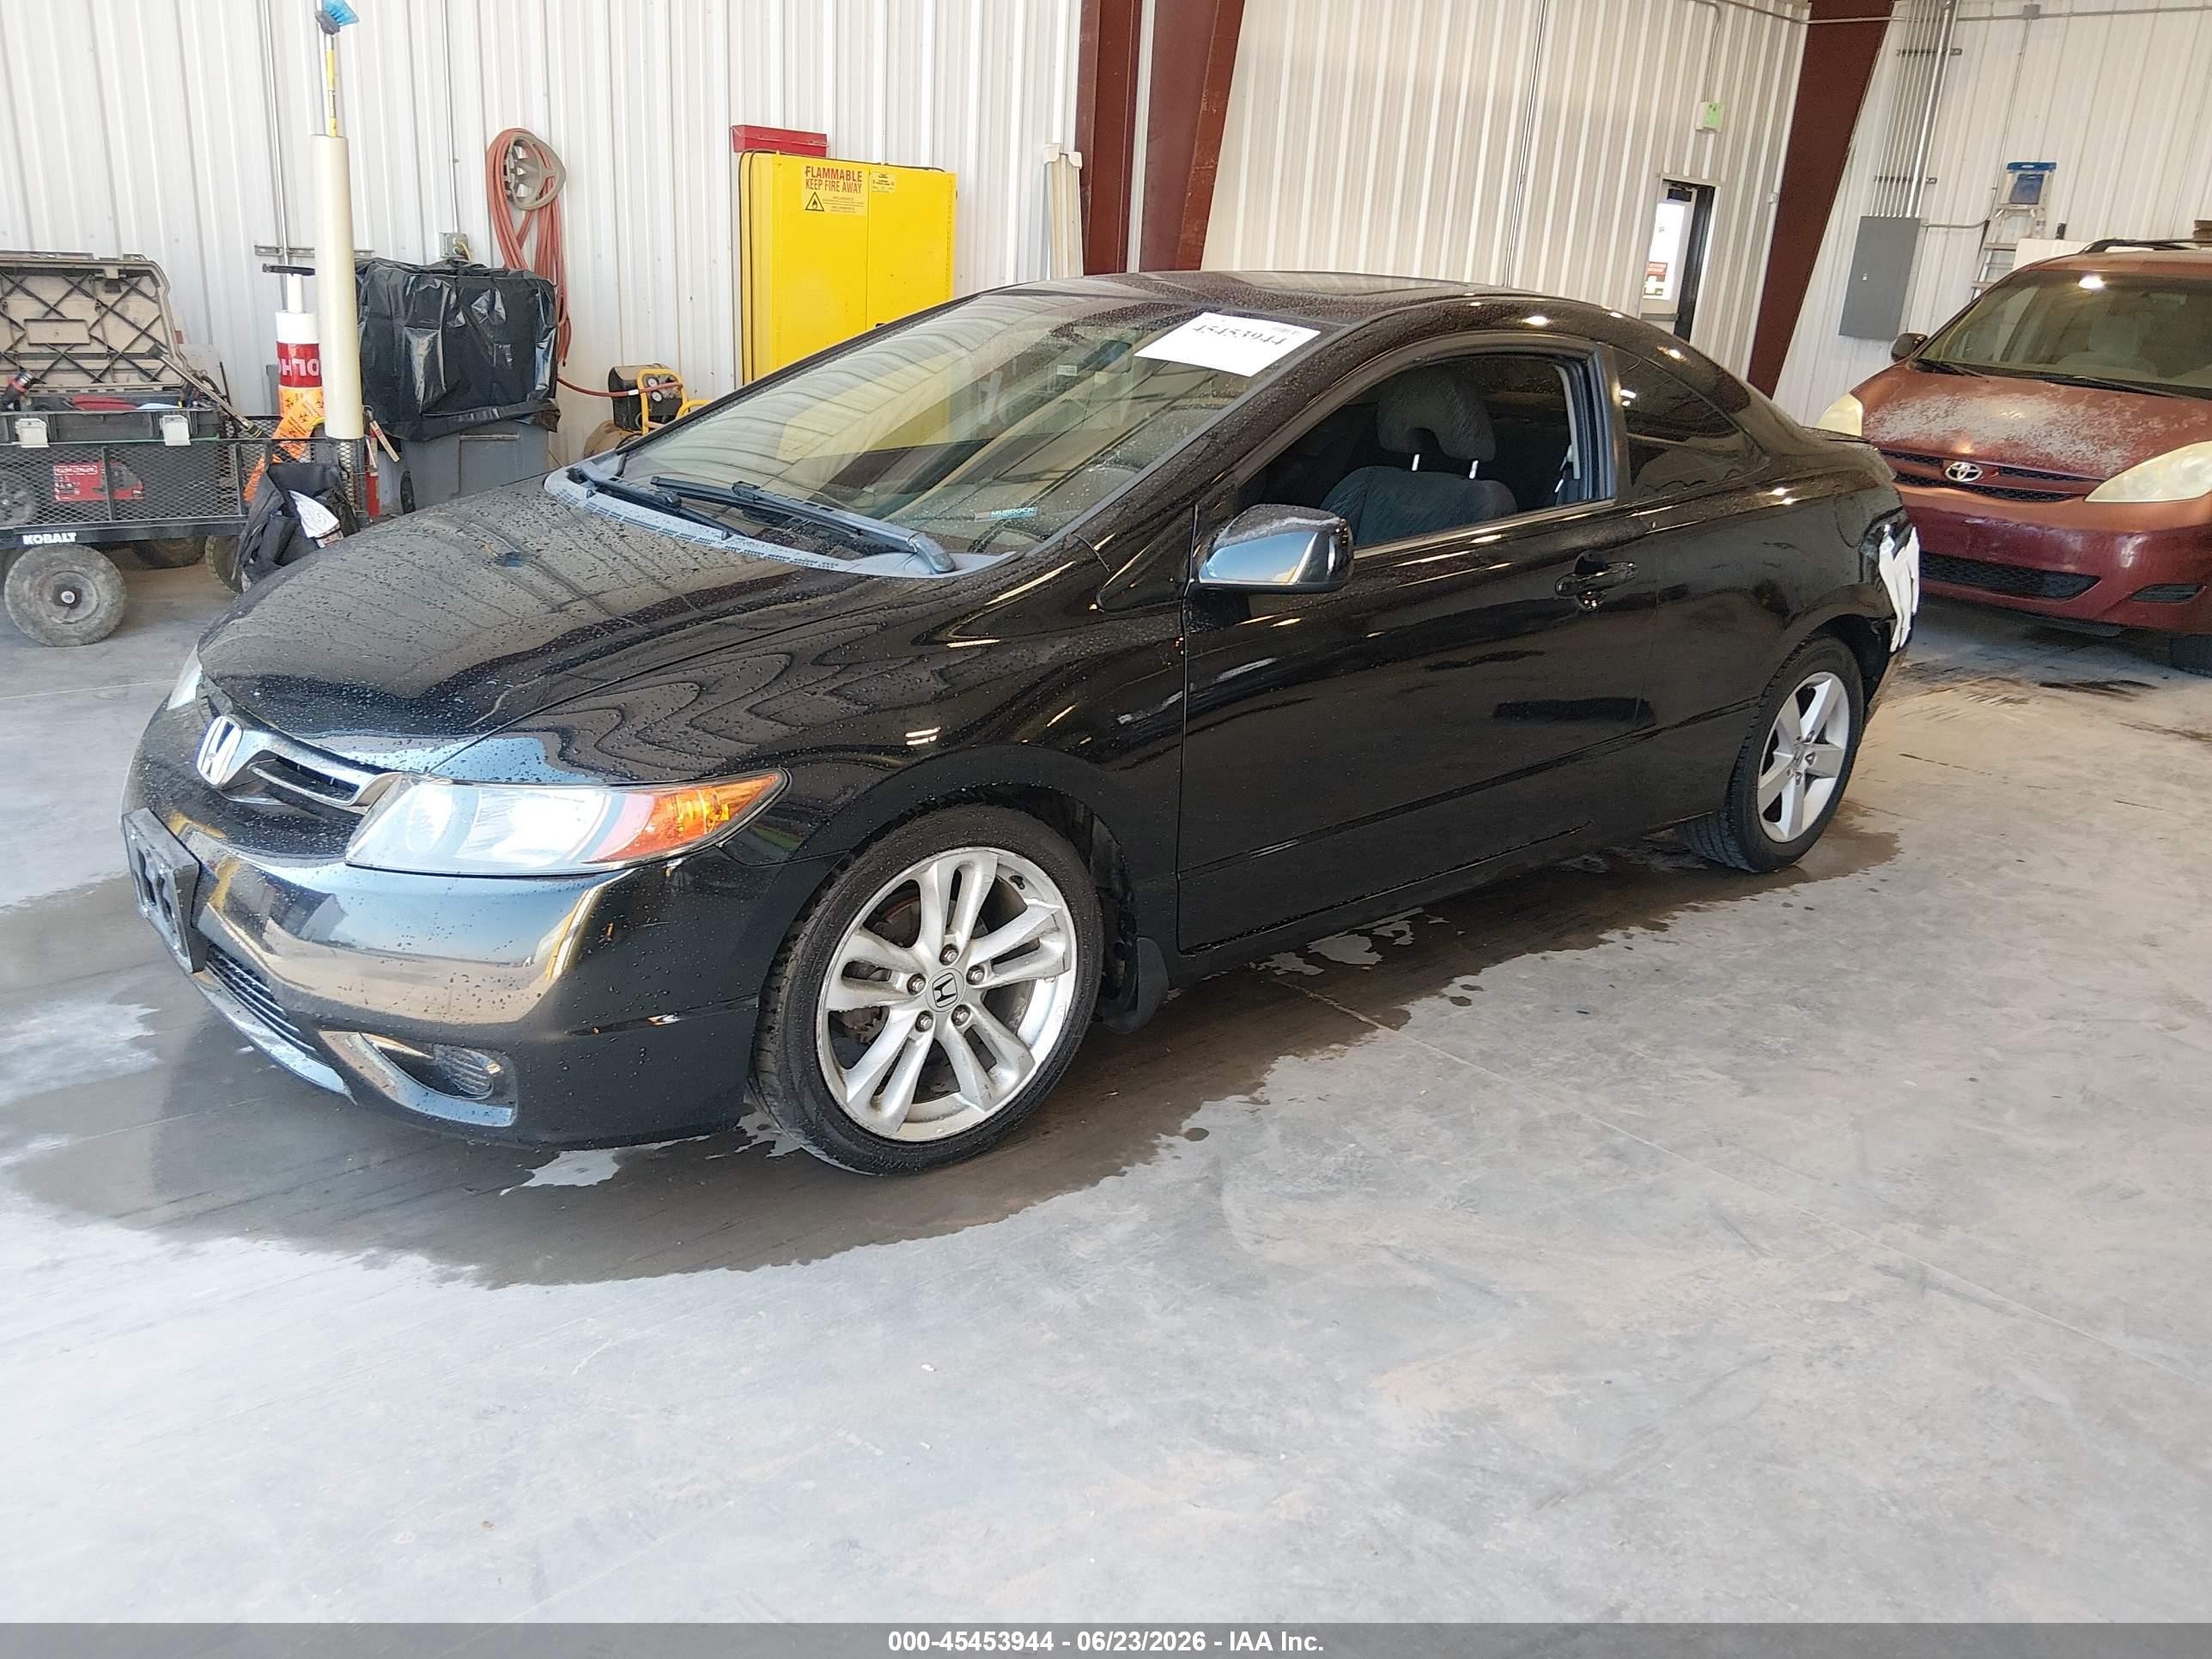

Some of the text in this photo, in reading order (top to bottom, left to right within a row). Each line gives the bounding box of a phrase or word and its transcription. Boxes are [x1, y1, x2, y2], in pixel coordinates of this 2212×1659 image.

[805, 165, 863, 182] FLAMMABLE
[805, 178, 823, 190] KEEP
[824, 180, 840, 192] FIRE
[842, 183, 862, 194] AWAY
[23, 532, 76, 545] KOBALT
